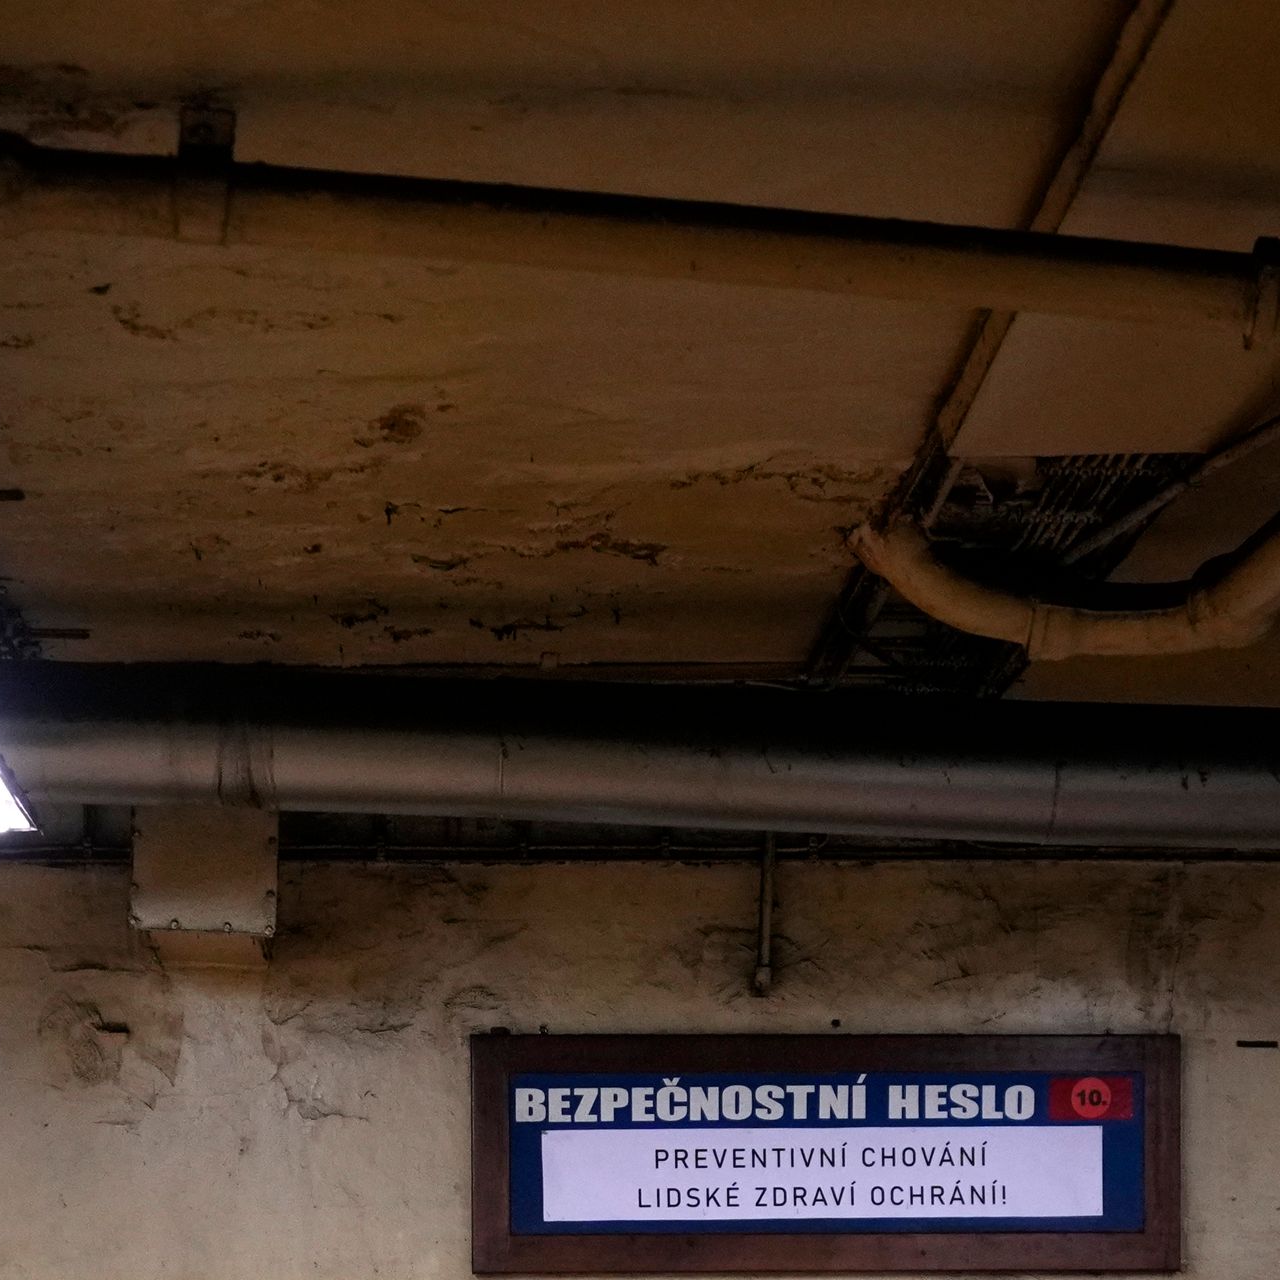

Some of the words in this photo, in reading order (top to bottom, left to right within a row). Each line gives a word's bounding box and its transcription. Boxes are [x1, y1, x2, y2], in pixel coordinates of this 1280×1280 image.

[514, 1074, 867, 1123] BEZPEČNOSTNÍ
[888, 1084, 1036, 1121] HESLO
[654, 1143, 848, 1170] PREVENTIVNÍ
[862, 1142, 988, 1168] CHOVÁNÍ
[638, 1182, 741, 1208] LIDSKÉ
[755, 1181, 857, 1207] ZDRAVÍ
[871, 1179, 1009, 1206] OCHRÁNÍ!
